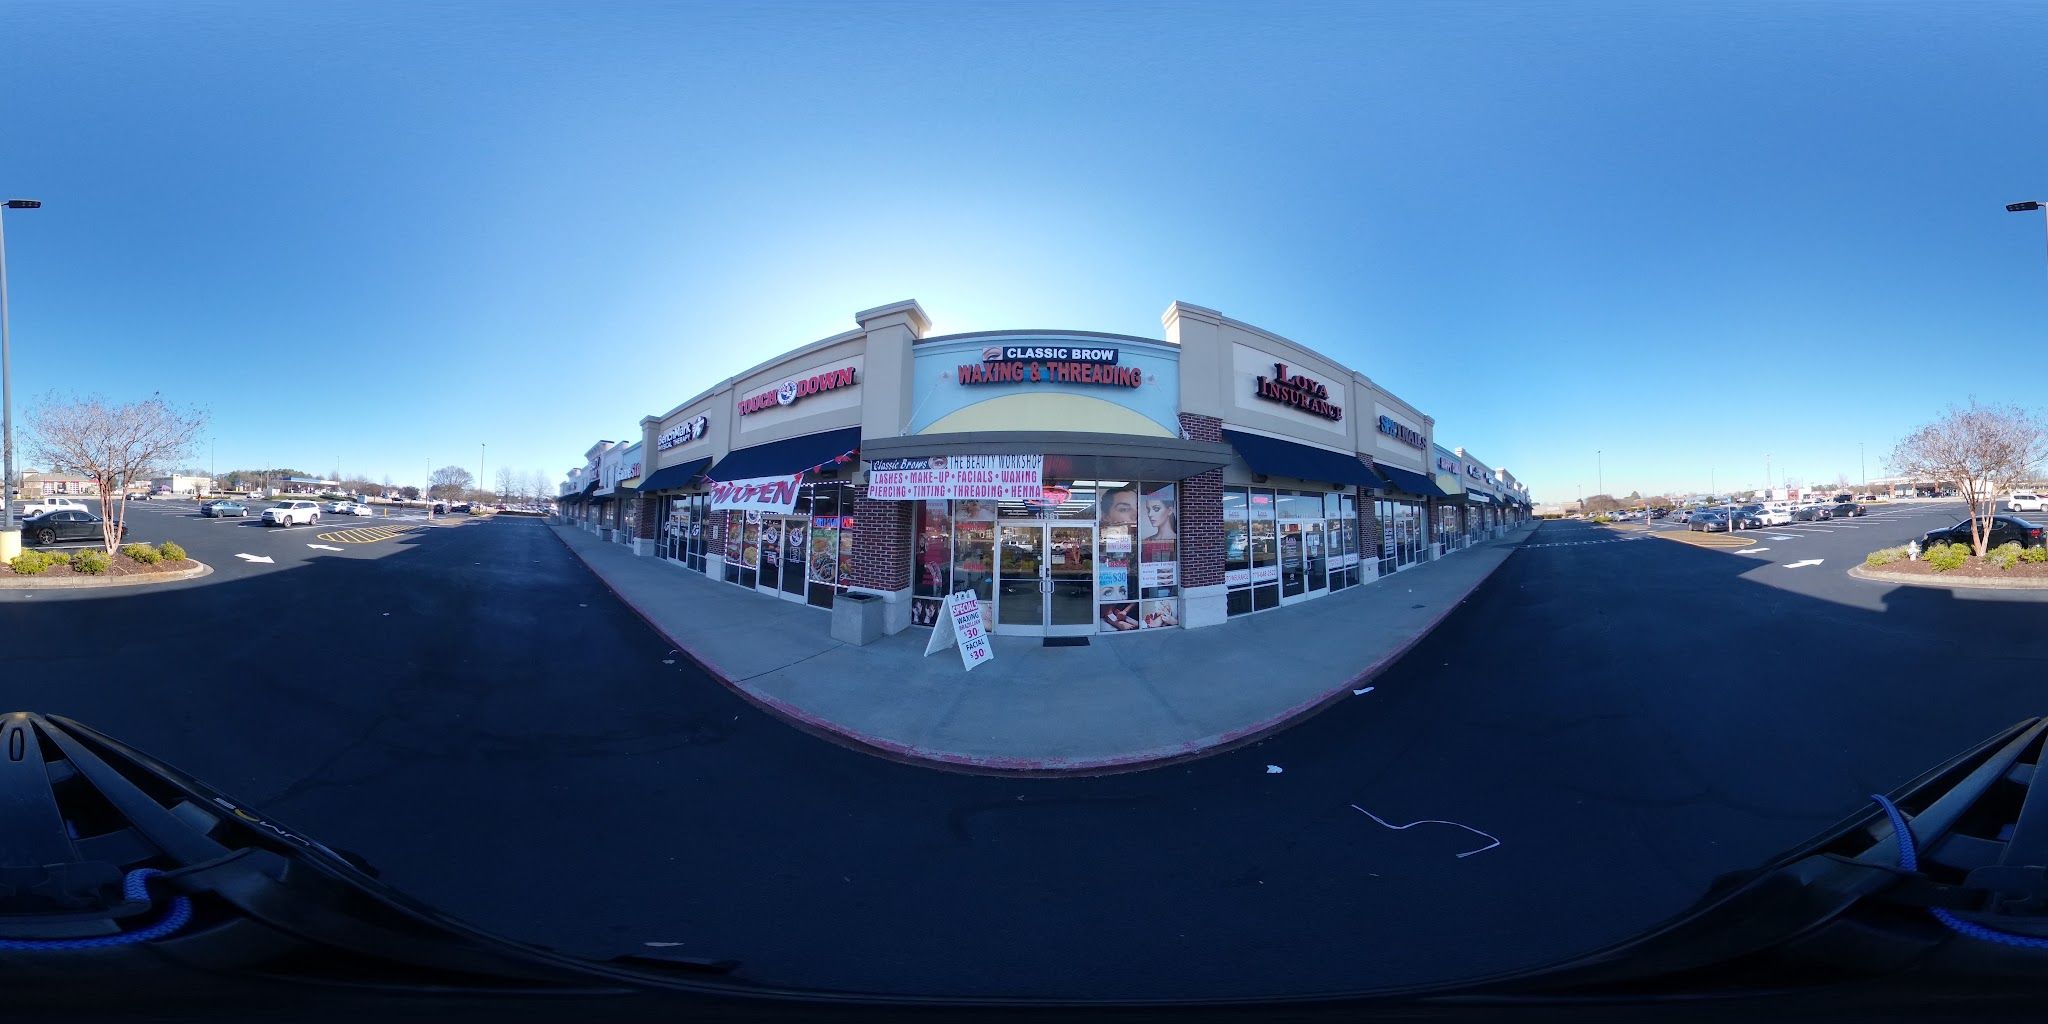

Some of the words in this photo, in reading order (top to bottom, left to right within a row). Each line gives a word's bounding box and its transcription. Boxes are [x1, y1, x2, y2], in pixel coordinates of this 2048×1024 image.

[1006, 348, 1068, 359] CLASSIC
[1071, 349, 1114, 361] BROW
[957, 362, 1024, 385] WAXING
[1029, 361, 1042, 382] &
[1046, 361, 1142, 389] THREADING
[737, 388, 778, 416] TOUCH
[796, 366, 856, 397] DOWN
[1257, 375, 1343, 422] INSURANCE
[873, 458, 899, 471] Classic
[900, 458, 928, 469] Brows
[950, 455, 963, 470] THE
[966, 455, 996, 469] BEAUTY
[999, 454, 1042, 470] WORKSHOP
[874, 471, 904, 485] LASHES
[910, 471, 950, 484] MAKE-UP
[957, 470, 993, 483] FACIALS
[1001, 470, 1037, 483] WAXING
[869, 485, 906, 498] PIERCING
[913, 485, 945, 497] TINTING
[953, 485, 1003, 498] THREADING
[1011, 485, 1041, 498] HENNA
[952, 600, 978, 615] SPECIALS
[957, 612, 979, 625] WAXING
[965, 639, 985, 650] FACIAL
[970, 648, 985, 660] $30
